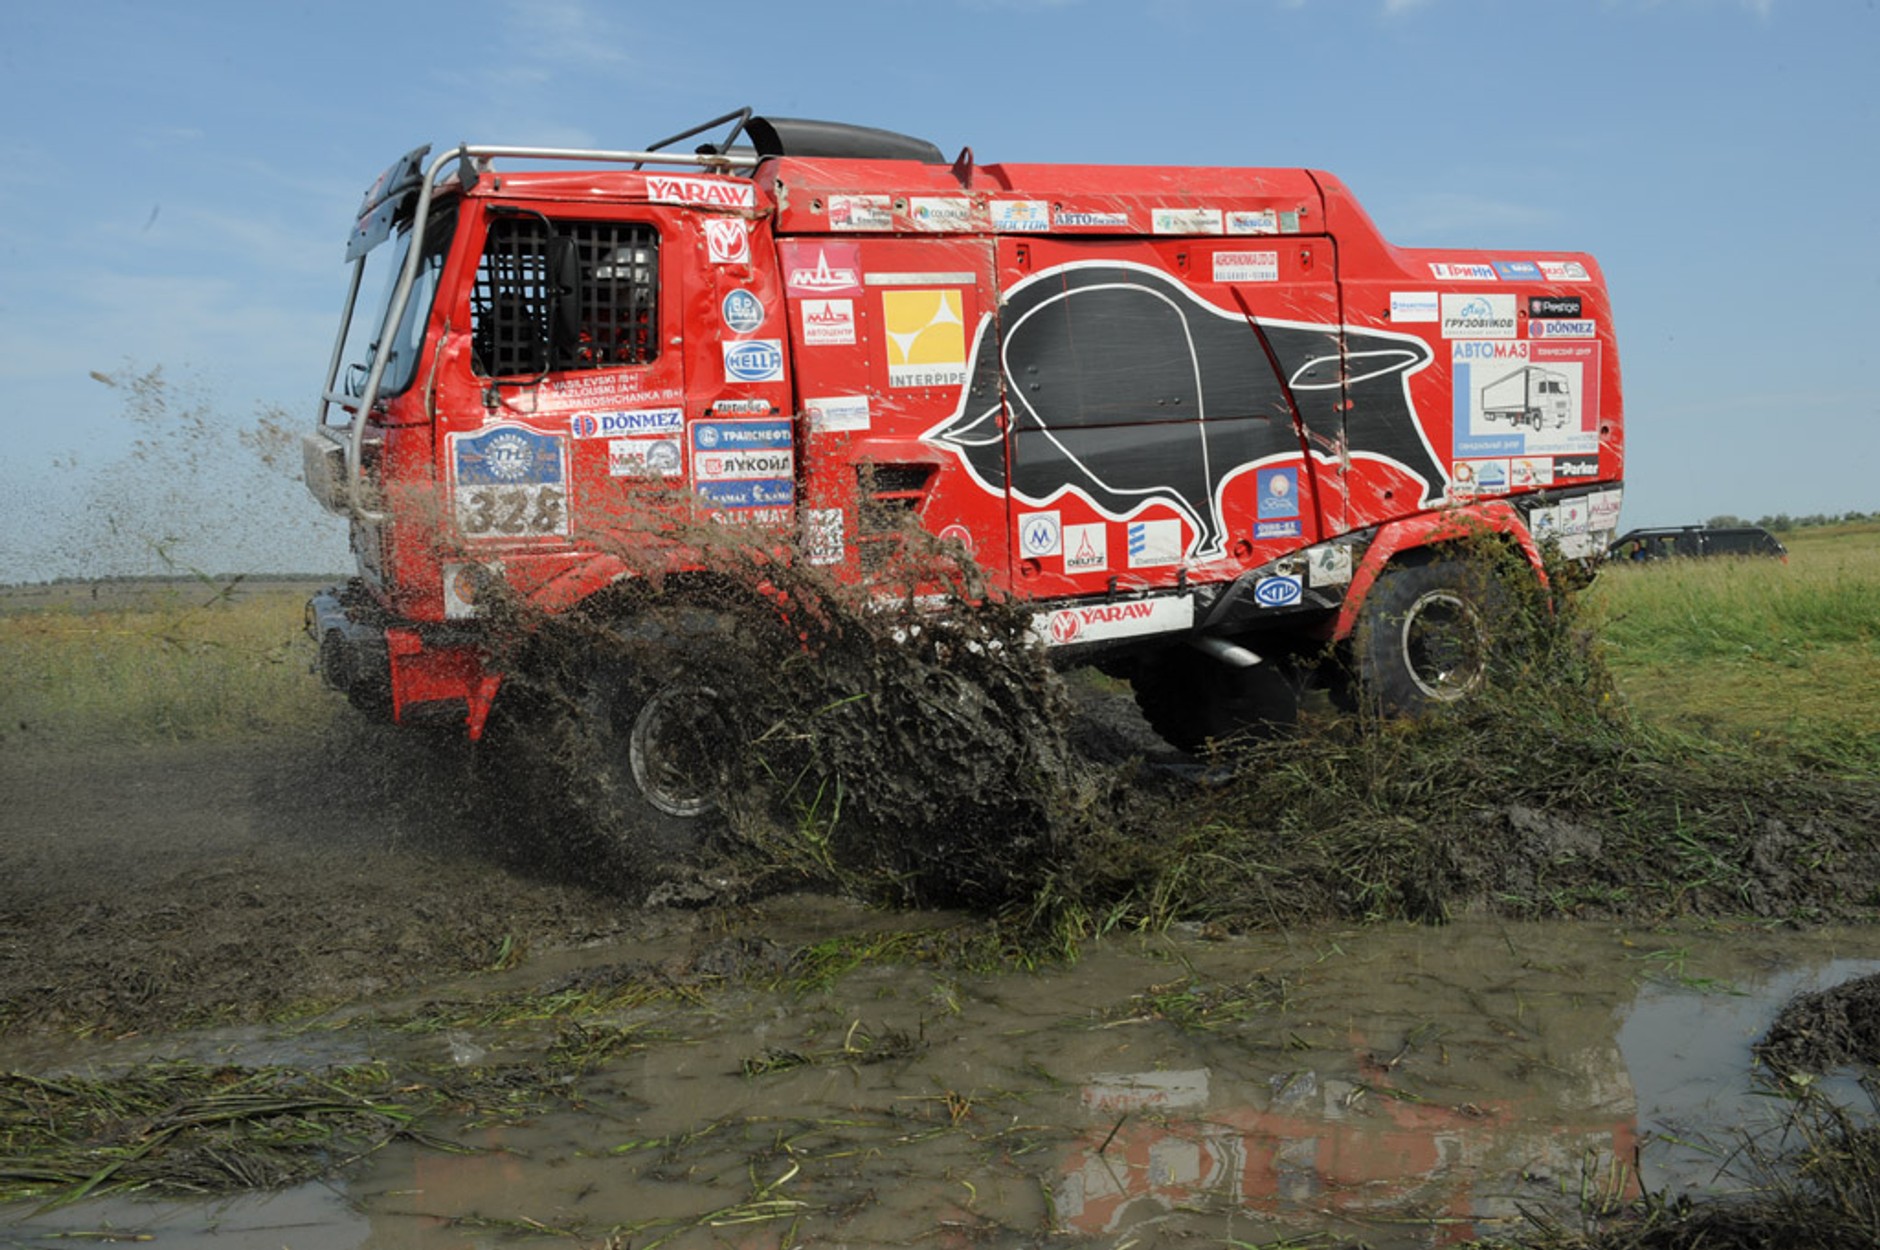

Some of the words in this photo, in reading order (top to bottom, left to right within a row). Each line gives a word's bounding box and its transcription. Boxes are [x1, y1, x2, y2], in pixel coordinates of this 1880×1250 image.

[649, 179, 748, 206] YARAW
[1454, 342, 1529, 359] АВТОМАЗ
[729, 352, 782, 369] HELLA
[889, 372, 967, 388] INTERPIPE
[602, 411, 680, 429] DÖNMEZ
[1562, 461, 1599, 475] Parker
[1067, 556, 1104, 567] DEUTZ
[1079, 601, 1155, 625] YARAW
